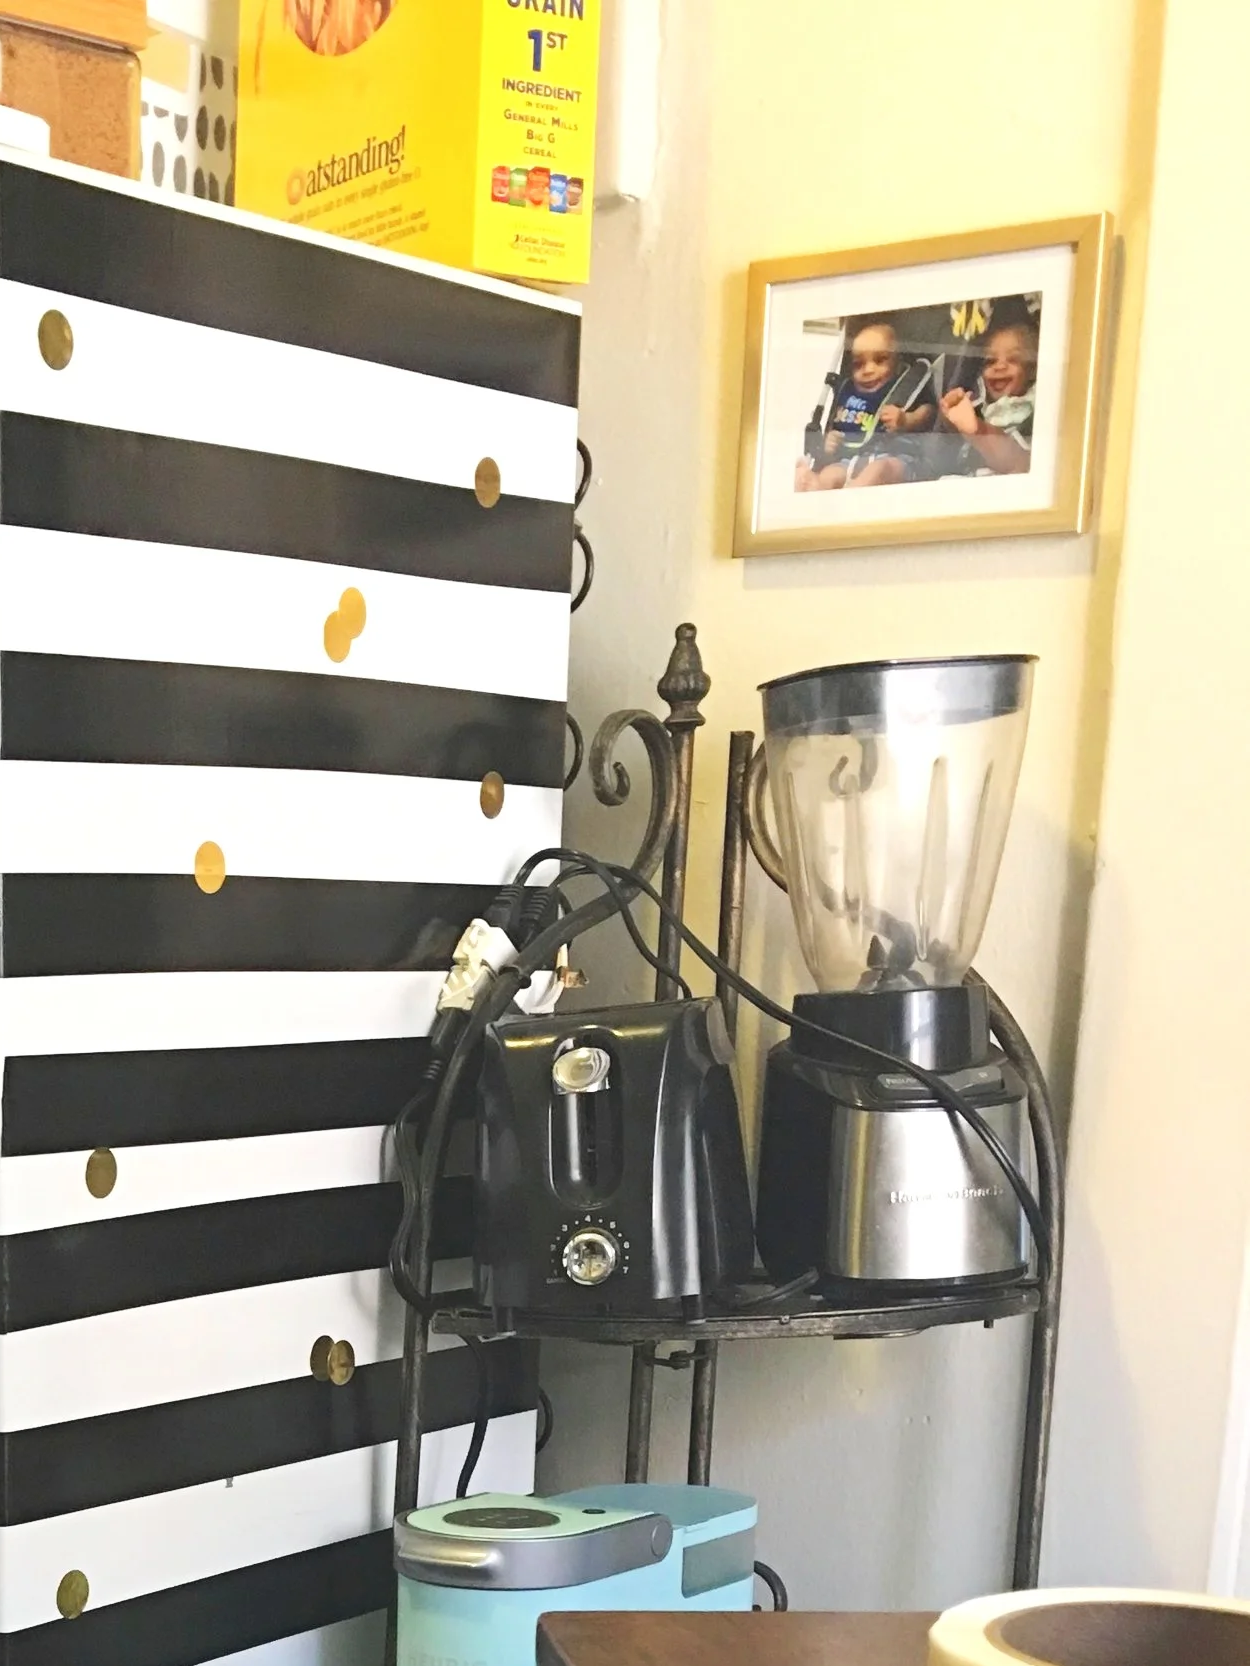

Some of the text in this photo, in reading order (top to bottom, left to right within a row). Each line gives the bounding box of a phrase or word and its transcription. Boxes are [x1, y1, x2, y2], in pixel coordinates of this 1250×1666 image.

[501, 77, 582, 103] INGREDIENT
[503, 108, 578, 131] GENERAL MILLS
[548, 132, 556, 144] G
[523, 146, 556, 159] CEREAL
